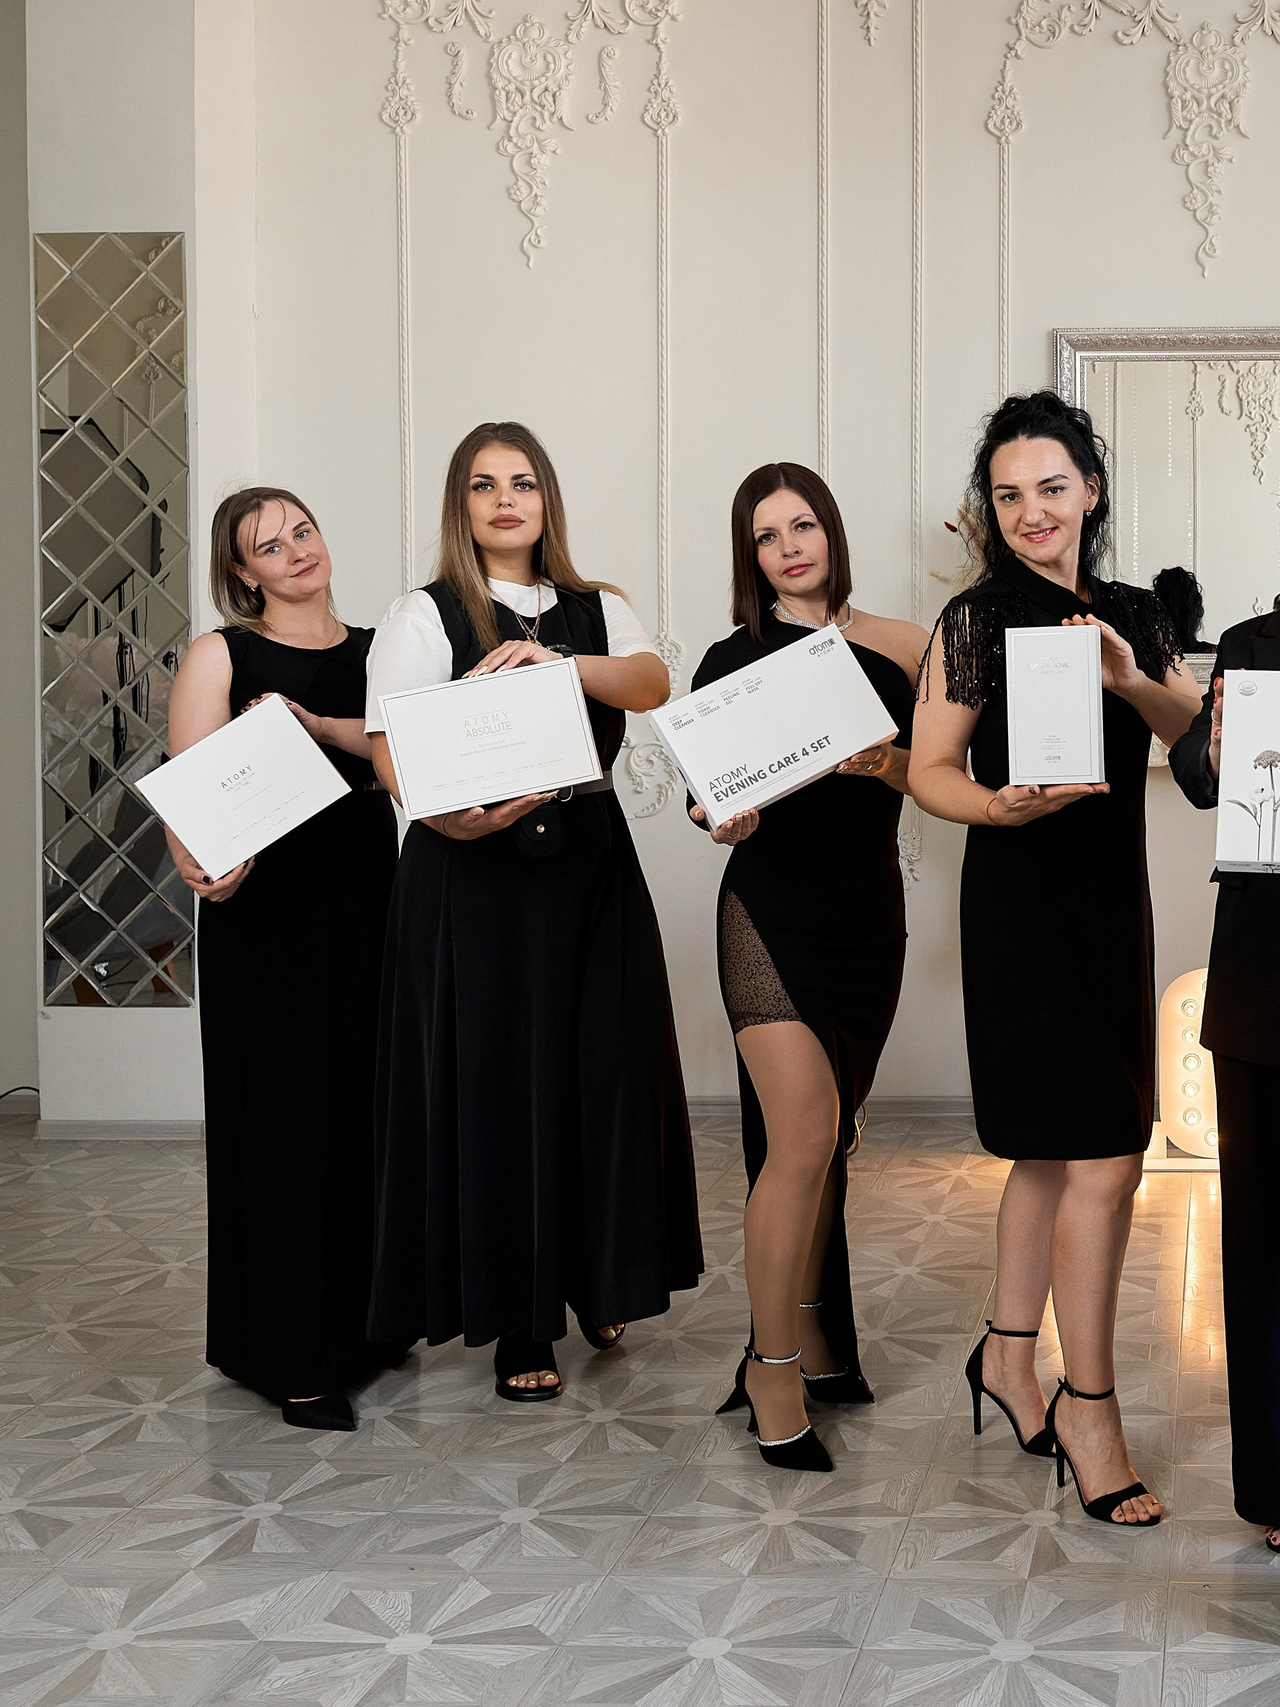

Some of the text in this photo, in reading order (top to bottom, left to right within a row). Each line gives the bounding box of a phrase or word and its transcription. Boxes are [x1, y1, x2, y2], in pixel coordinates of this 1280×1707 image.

[464, 711, 509, 729] ATOMY
[700, 705, 720, 718] CLEANSER
[466, 721, 513, 739] ABSOLUTE
[674, 718, 695, 731] CLEANSER
[220, 764, 253, 789] ATOMY
[709, 763, 749, 793] ATOMY
[713, 735, 832, 803] EVENING CARE 4 SET
